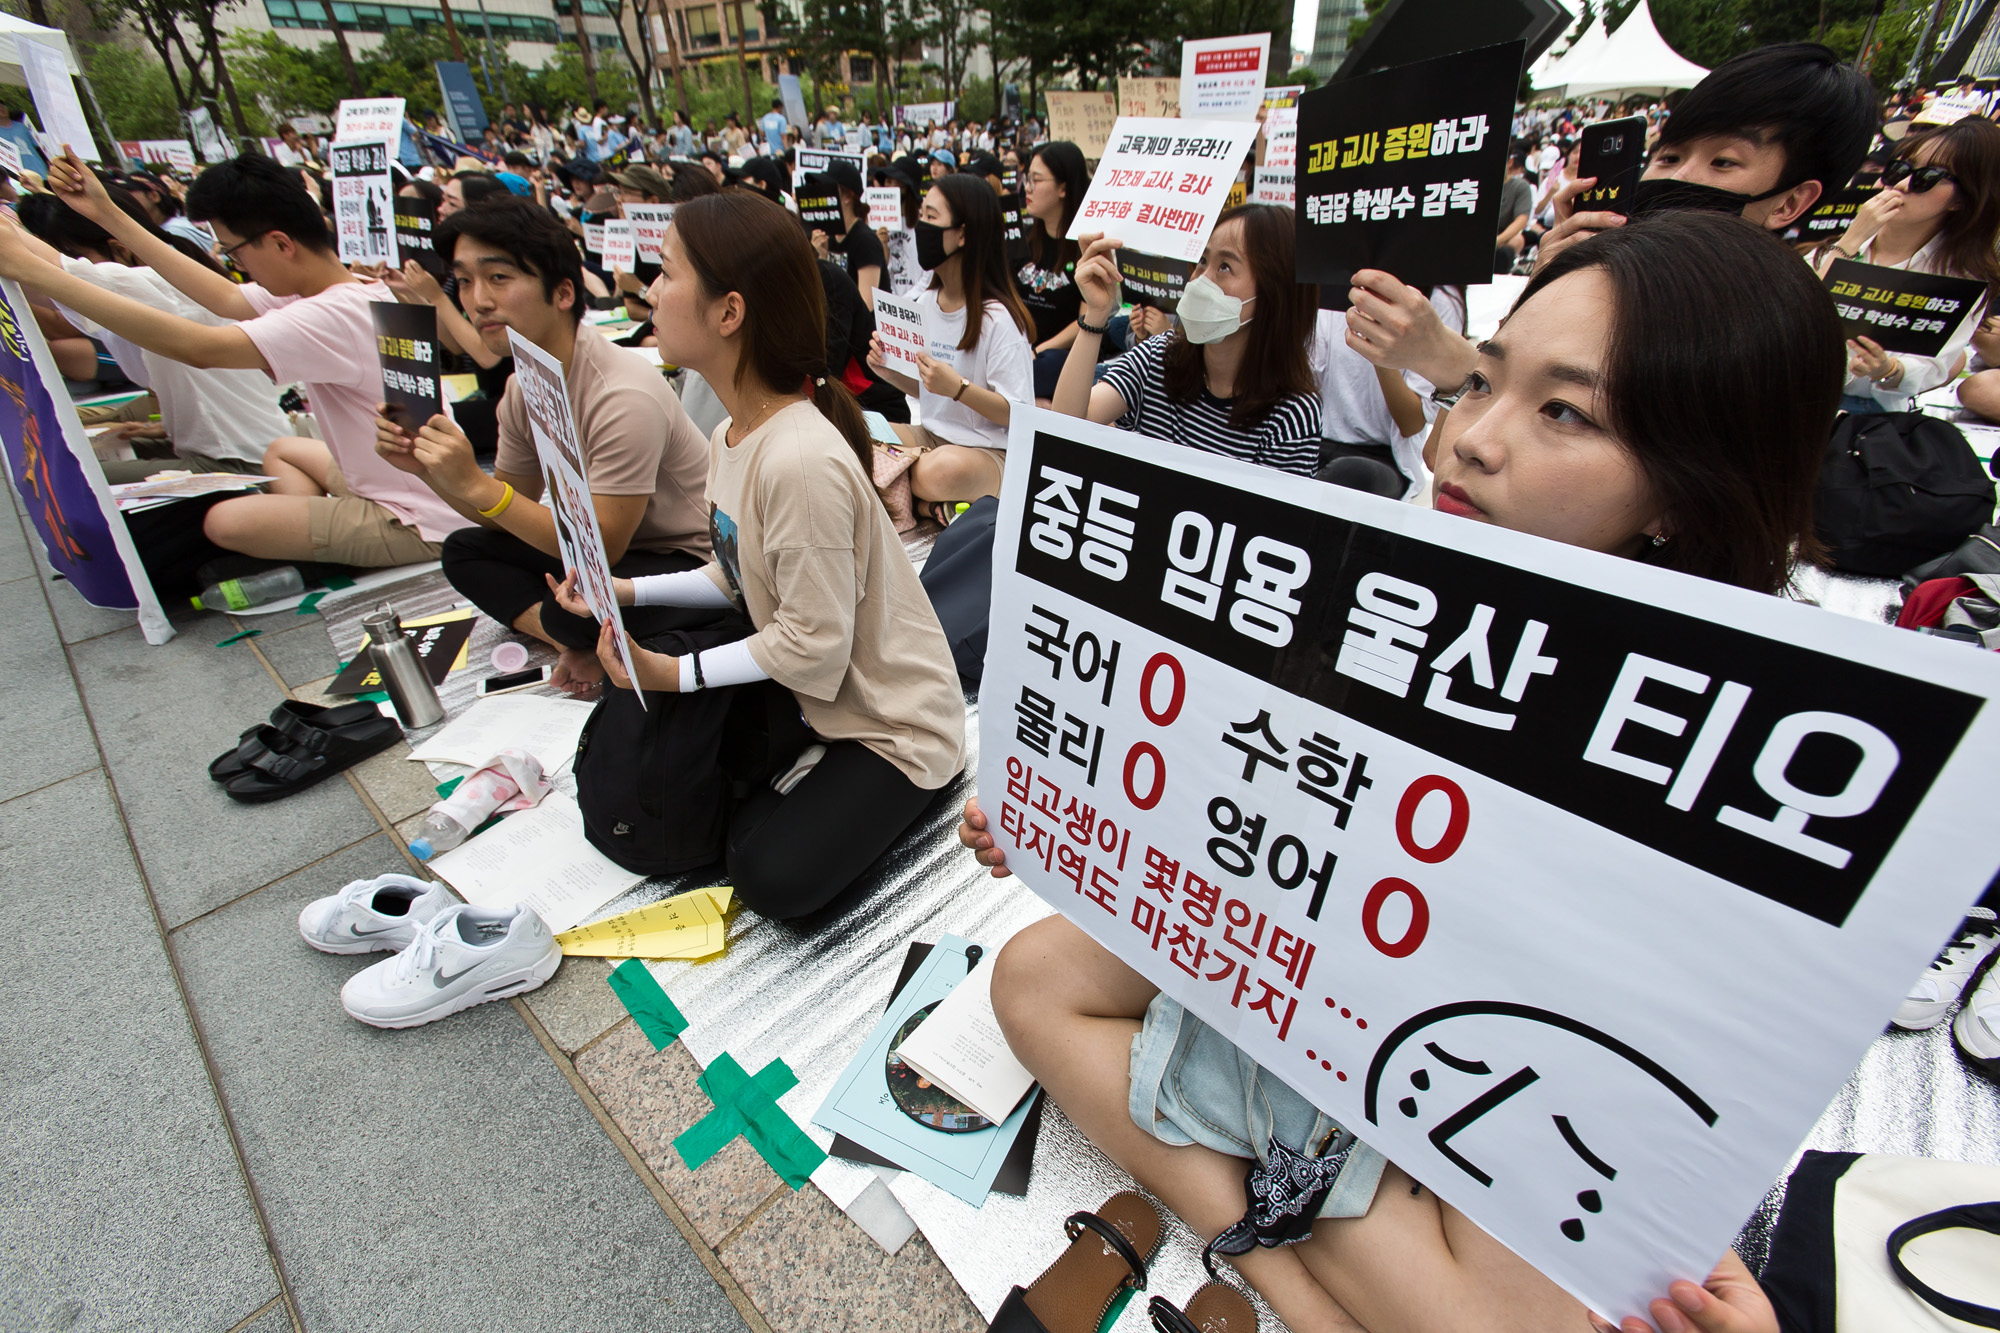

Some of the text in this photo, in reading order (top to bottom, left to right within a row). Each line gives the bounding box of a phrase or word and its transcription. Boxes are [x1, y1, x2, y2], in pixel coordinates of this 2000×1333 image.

[1116, 134, 1172, 156] 교육계의
[1308, 114, 1490, 174] 교과 교사 증원하라
[1104, 168, 1146, 187] 기간제
[1142, 170, 1174, 194] 교사,
[1306, 178, 1479, 225] 학급당 학생수 감축
[1136, 203, 1206, 235] 결사반대!
[1830, 280, 1960, 314] 교과 교사 증원하라
[1864, 310, 1910, 328] 학생수
[1910, 318, 1946, 334] 감축
[1029, 465, 1901, 870] 중등 임용 울산 티오
[1024, 604, 1470, 864] 국어 0 수학 0
[1005, 756, 1132, 872] 임고생이
[1014, 684, 1430, 959] 물리 0 영어 0
[1000, 800, 1120, 918] 타지역도
